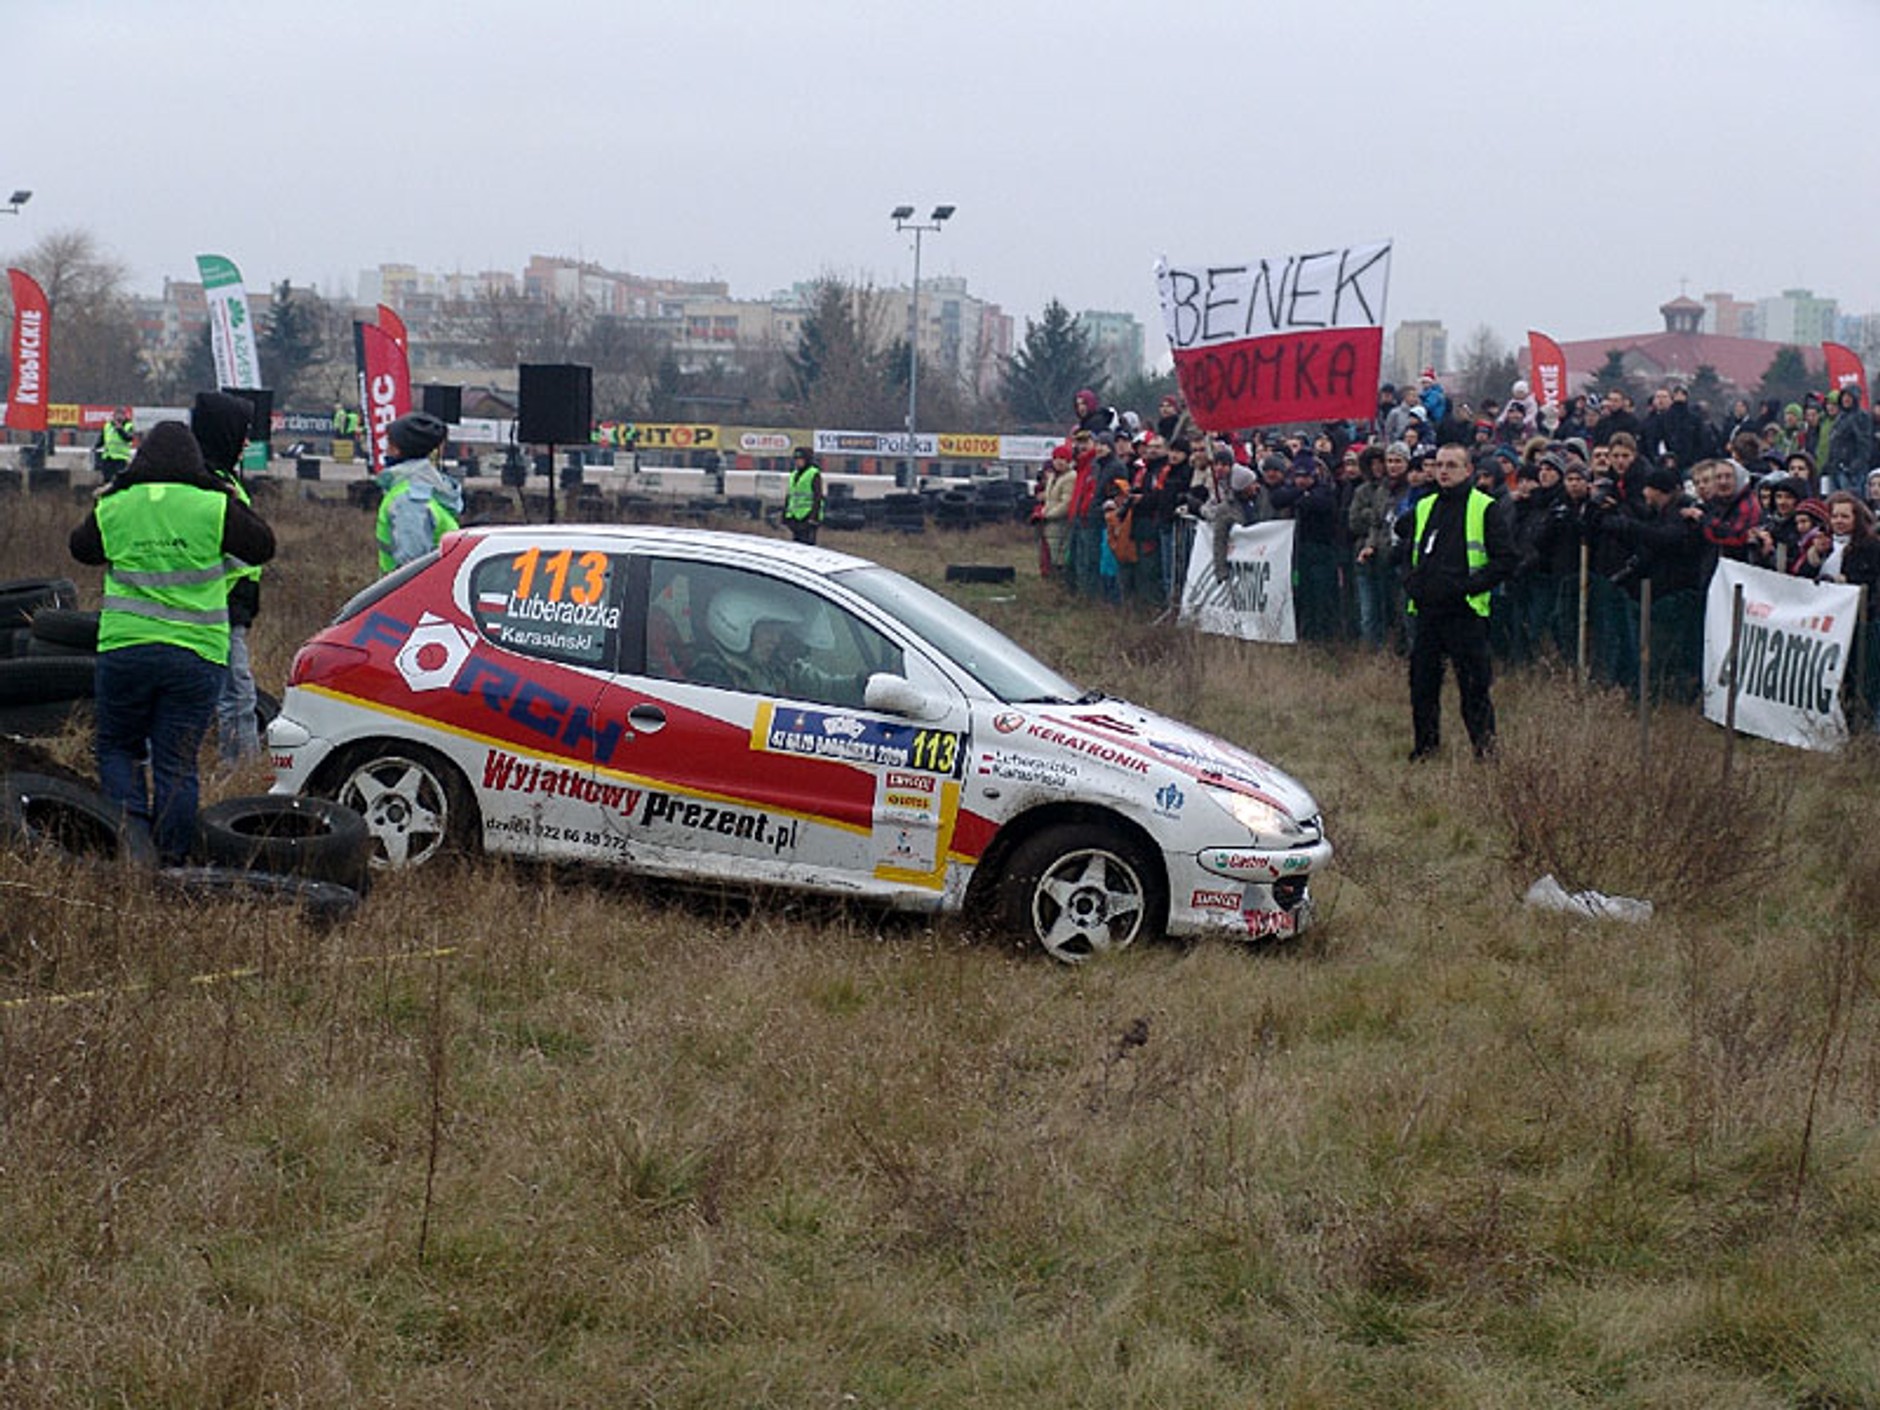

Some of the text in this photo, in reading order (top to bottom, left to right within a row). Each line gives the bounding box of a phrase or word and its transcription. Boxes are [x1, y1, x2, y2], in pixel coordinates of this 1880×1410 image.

[1169, 245, 1391, 347] BENEK
[956, 436, 998, 453] LOTOS
[512, 546, 608, 604] 113
[913, 730, 958, 772] 113
